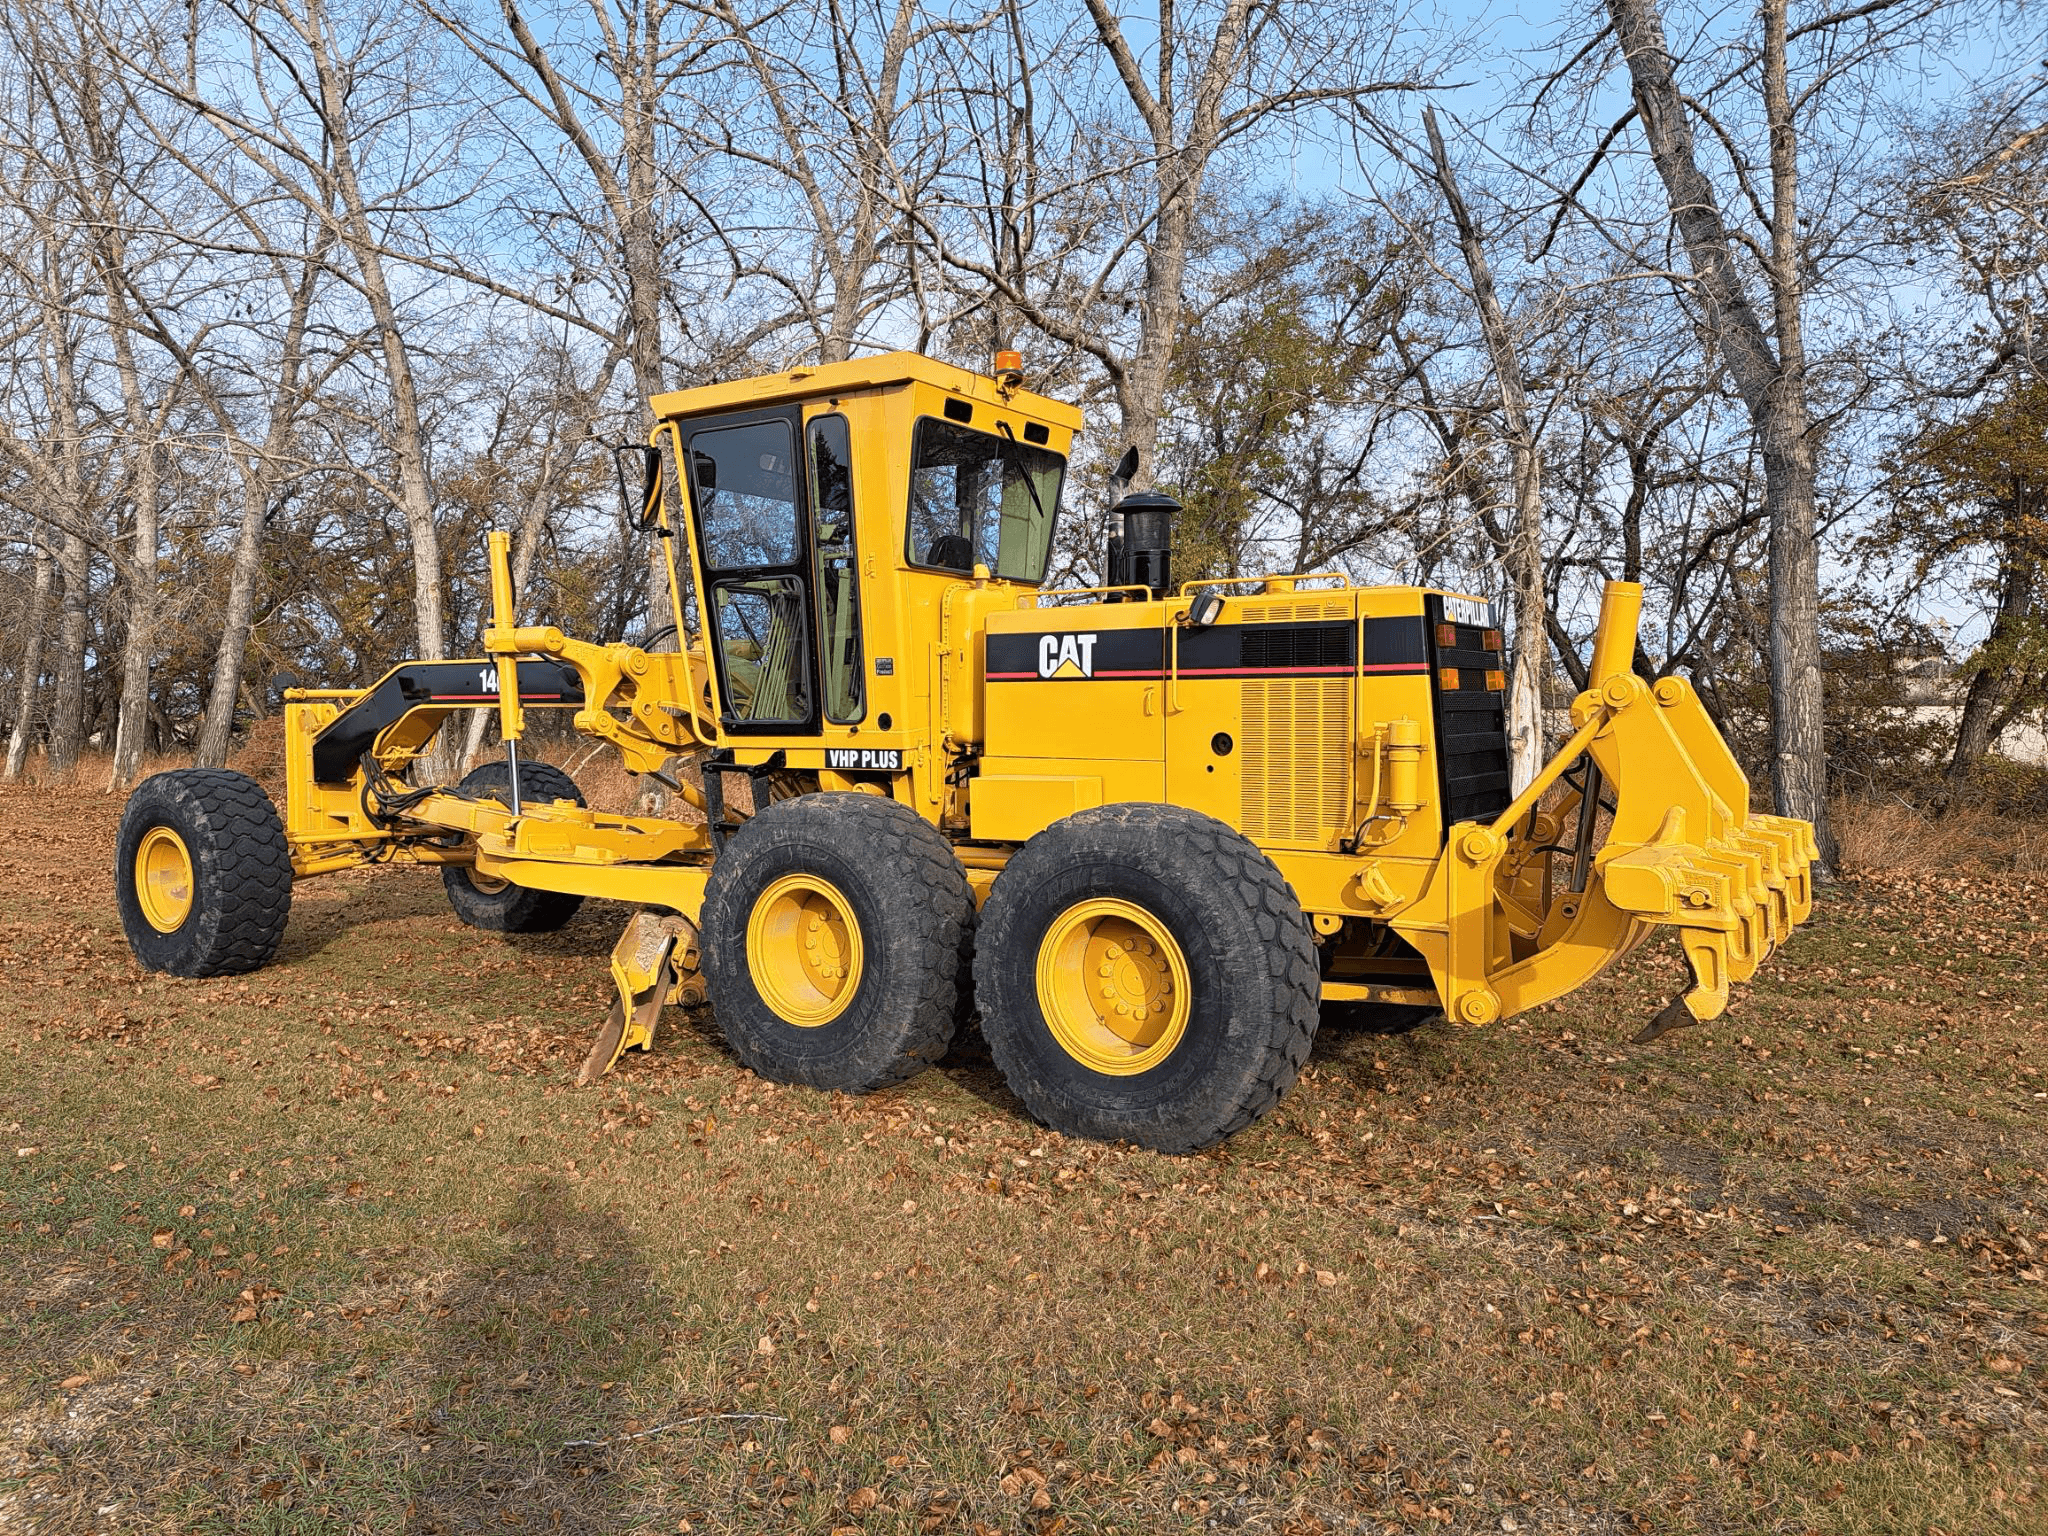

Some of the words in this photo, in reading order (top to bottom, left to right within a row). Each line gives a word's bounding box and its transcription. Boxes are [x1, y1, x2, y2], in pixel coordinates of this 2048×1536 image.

[1443, 595, 1489, 627] CATERPILLAR
[1039, 634, 1097, 678] CAT
[479, 669, 500, 692] 14
[829, 750, 859, 768] VHP
[861, 750, 898, 769] PLUS
